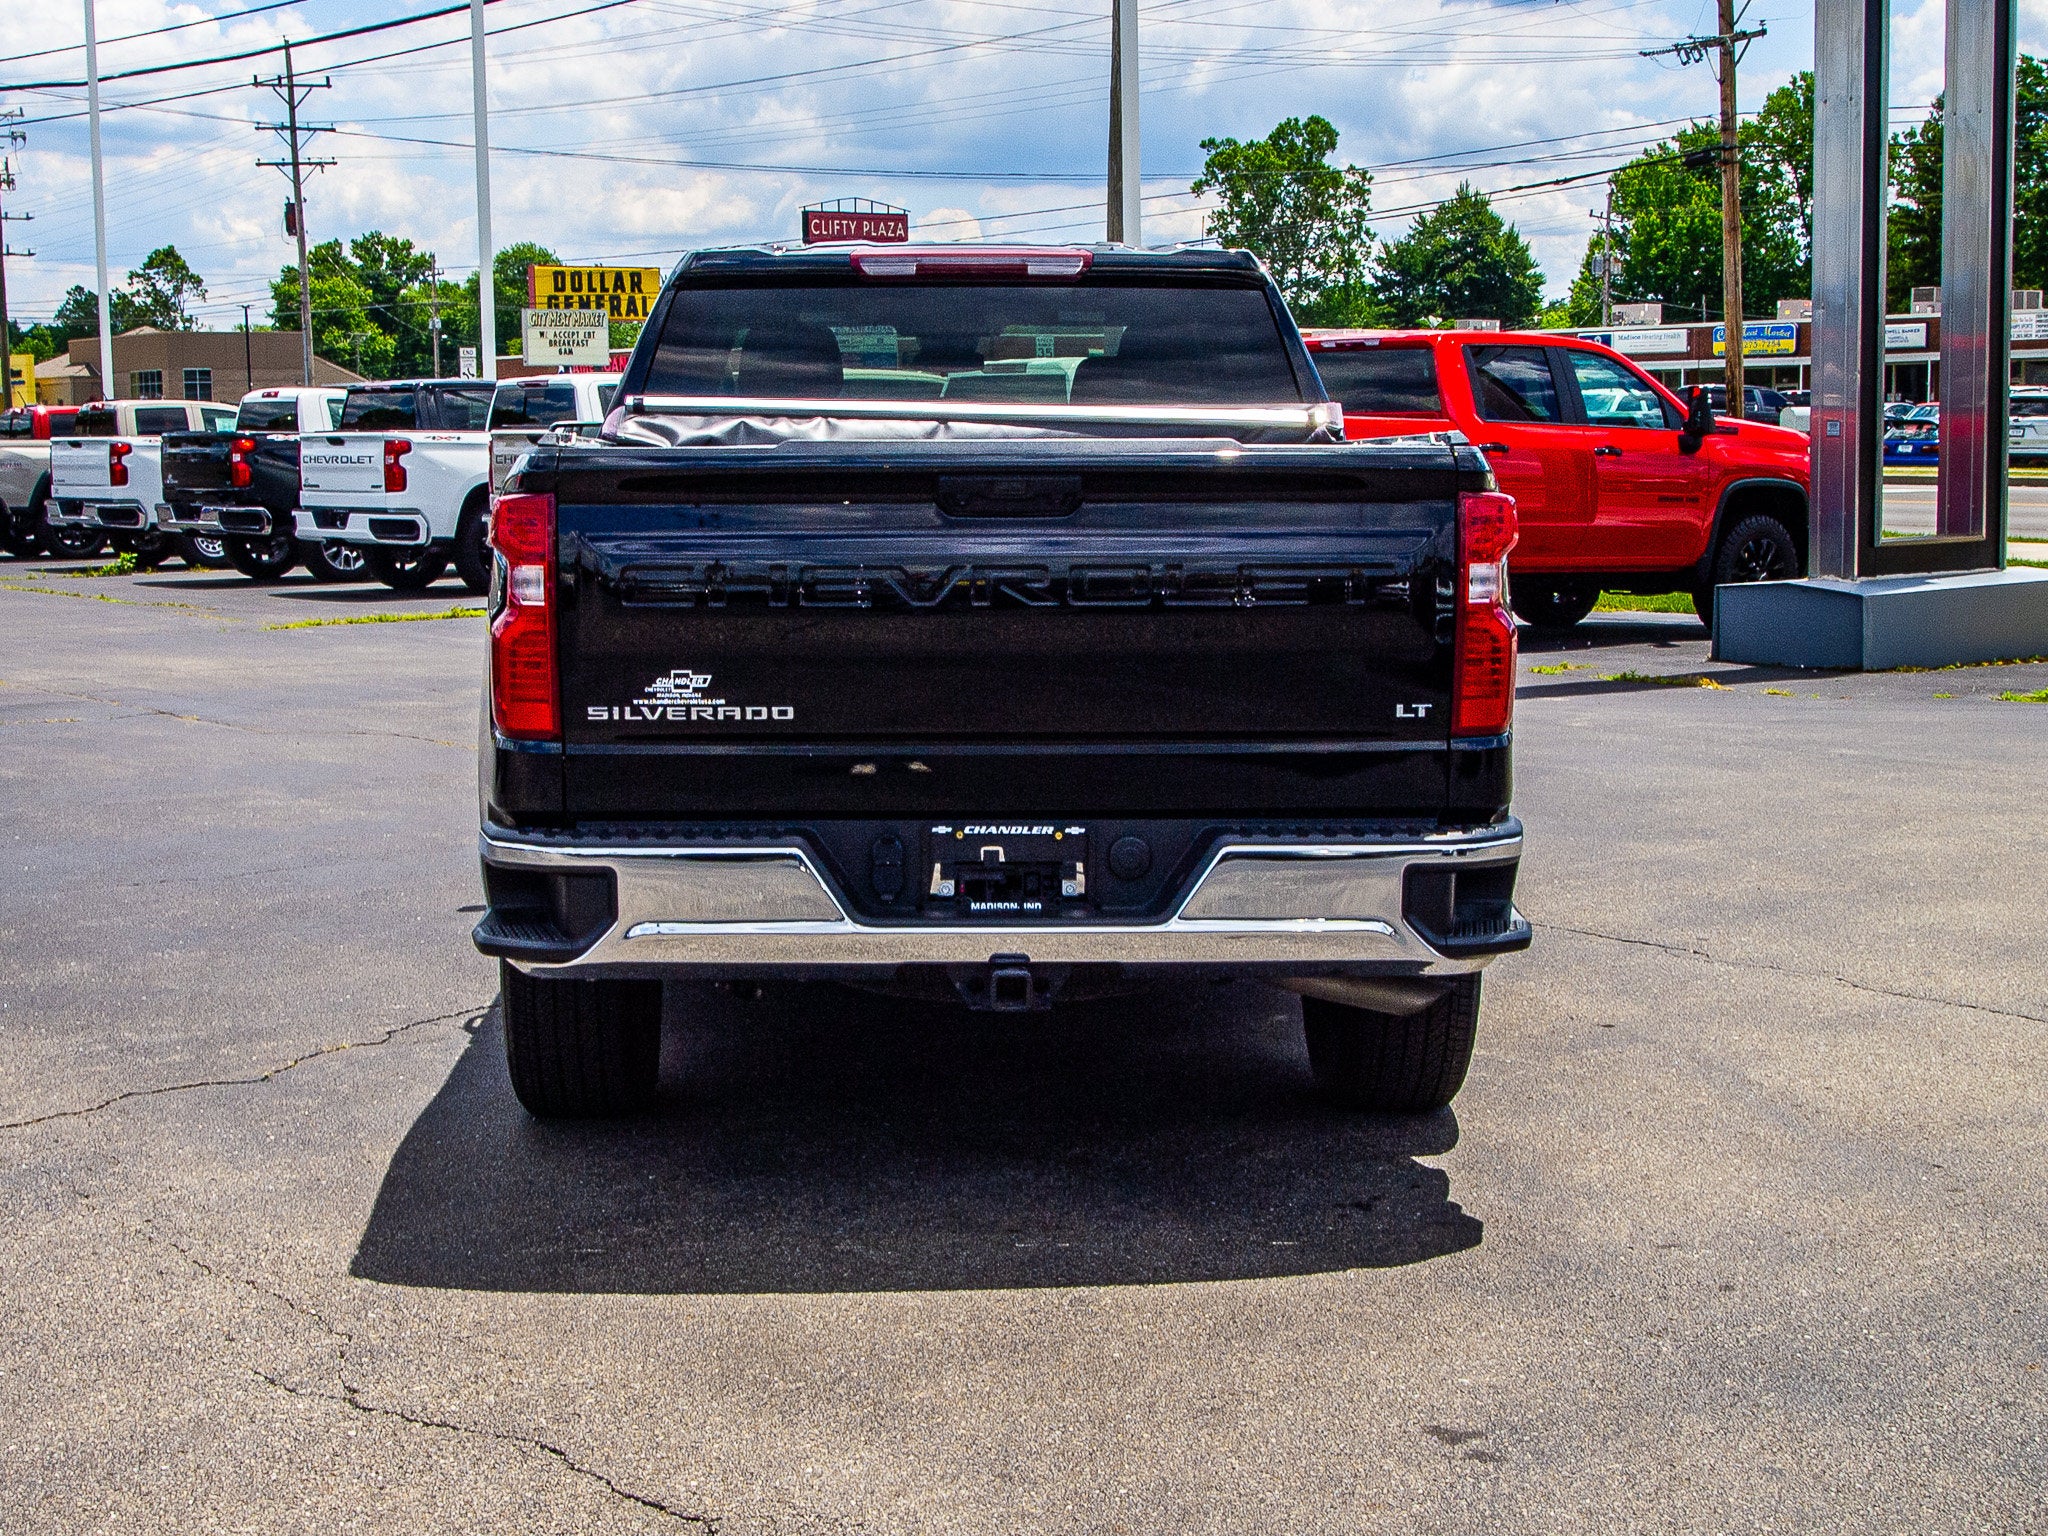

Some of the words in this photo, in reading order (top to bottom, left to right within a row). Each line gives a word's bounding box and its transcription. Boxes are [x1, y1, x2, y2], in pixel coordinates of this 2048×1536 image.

[811, 219, 857, 235] CLIFTY
[863, 221, 905, 237] PLAZA
[552, 270, 643, 293] DOLLAR
[546, 294, 650, 317] GENERAL
[530, 312, 548, 327] CITY
[548, 312, 571, 327] MEAT
[572, 312, 605, 327] MARKET
[303, 455, 374, 464] CHEVROLET
[620, 564, 1396, 608] CHEVROLET
[655, 677, 704, 686] CHANDLER
[587, 706, 794, 720] SILVERADO
[1396, 704, 1432, 717] LT
[964, 826, 1054, 834] CHANDLER
